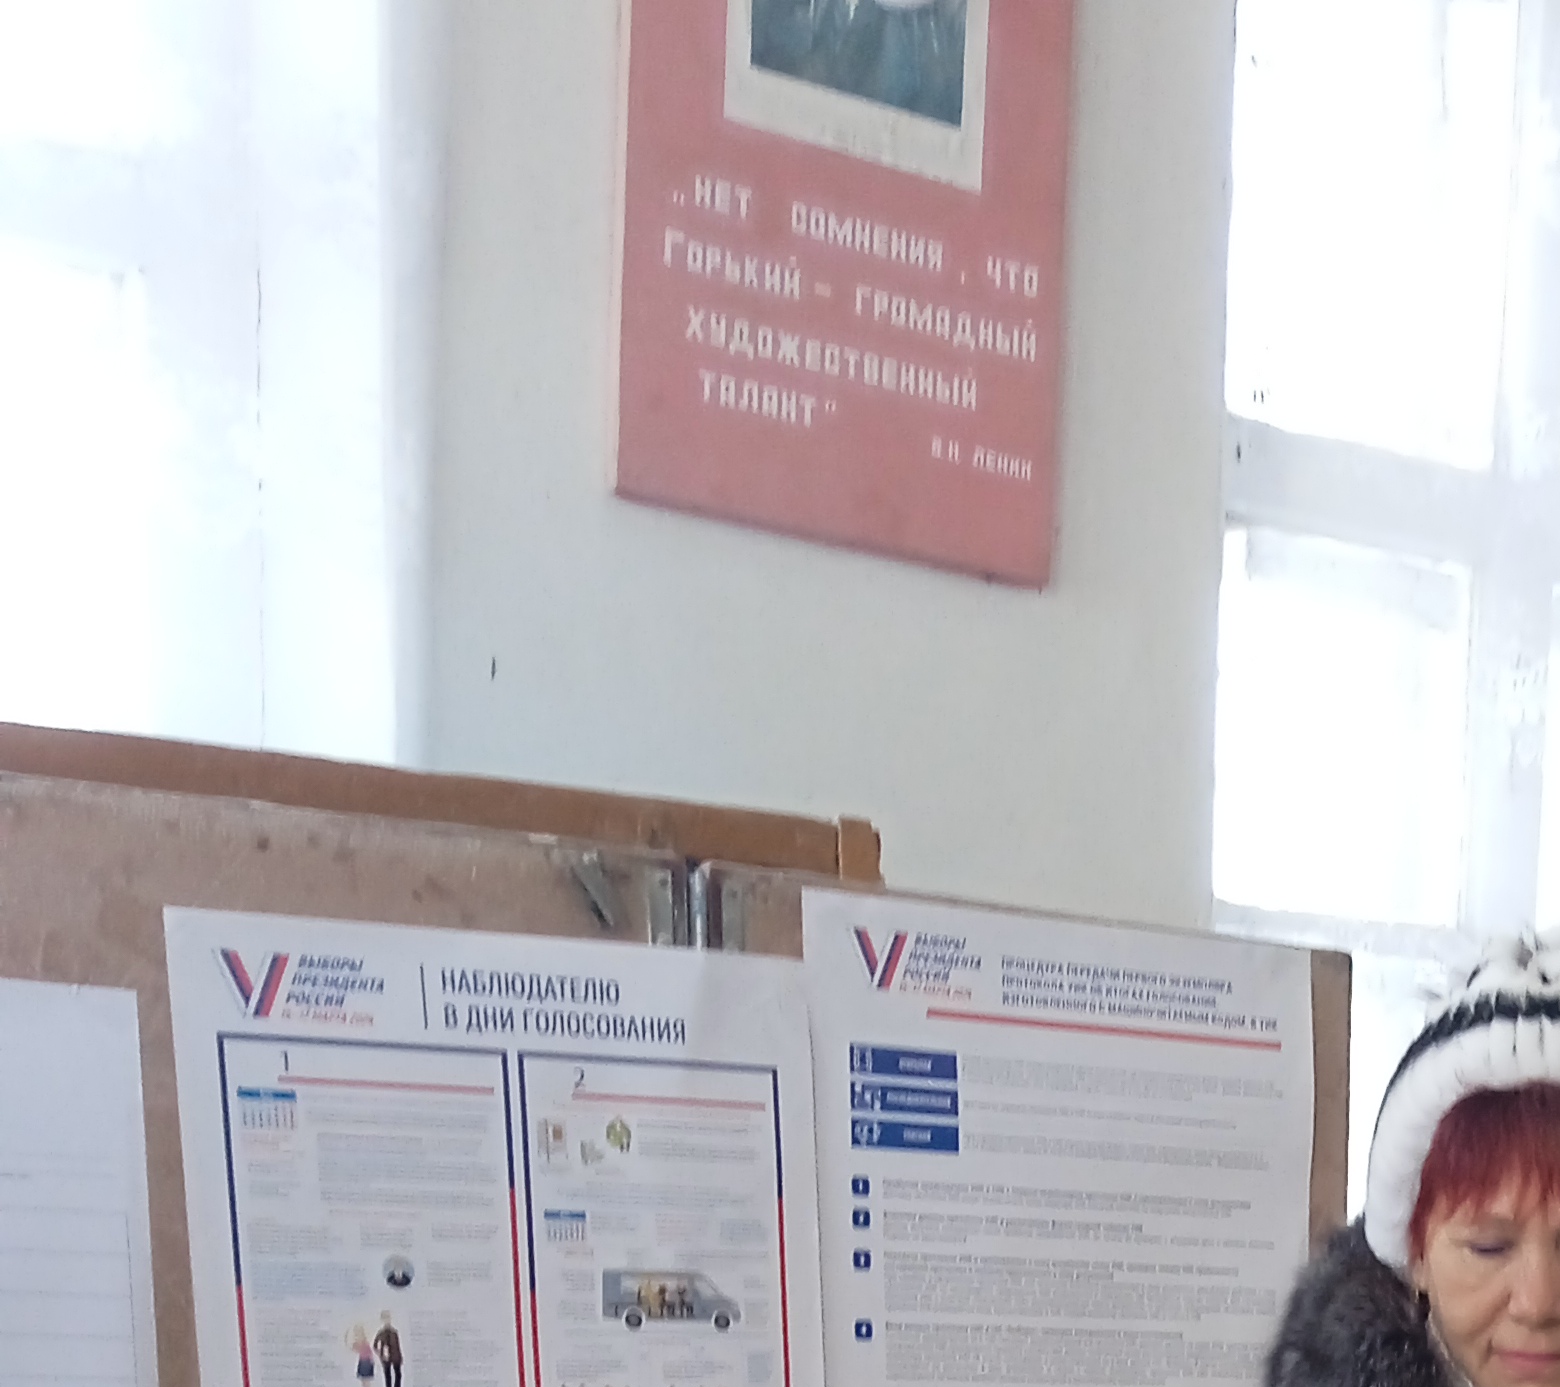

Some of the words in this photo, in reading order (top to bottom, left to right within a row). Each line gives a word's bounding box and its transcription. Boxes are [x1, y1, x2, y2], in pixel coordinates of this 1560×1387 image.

[986, 255, 1039, 298] ЧТО
[856, 282, 1037, 363] ГРОМАДНЫЙ
[686, 304, 977, 412] ХУДОЖЕСТВЕННЫЙ
[972, 444, 1032, 481] ЛЕНИН
[291, 971, 385, 995] ПРЕЗИДЕНТА
[298, 953, 365, 973] ВЫБОРЫ
[441, 966, 620, 1007] НАБЛЮДАТЕЛЮ
[444, 1002, 459, 1029] В
[466, 1003, 515, 1036] ДНИ
[522, 1006, 686, 1046] ГОЛОСОВАНИЯ
